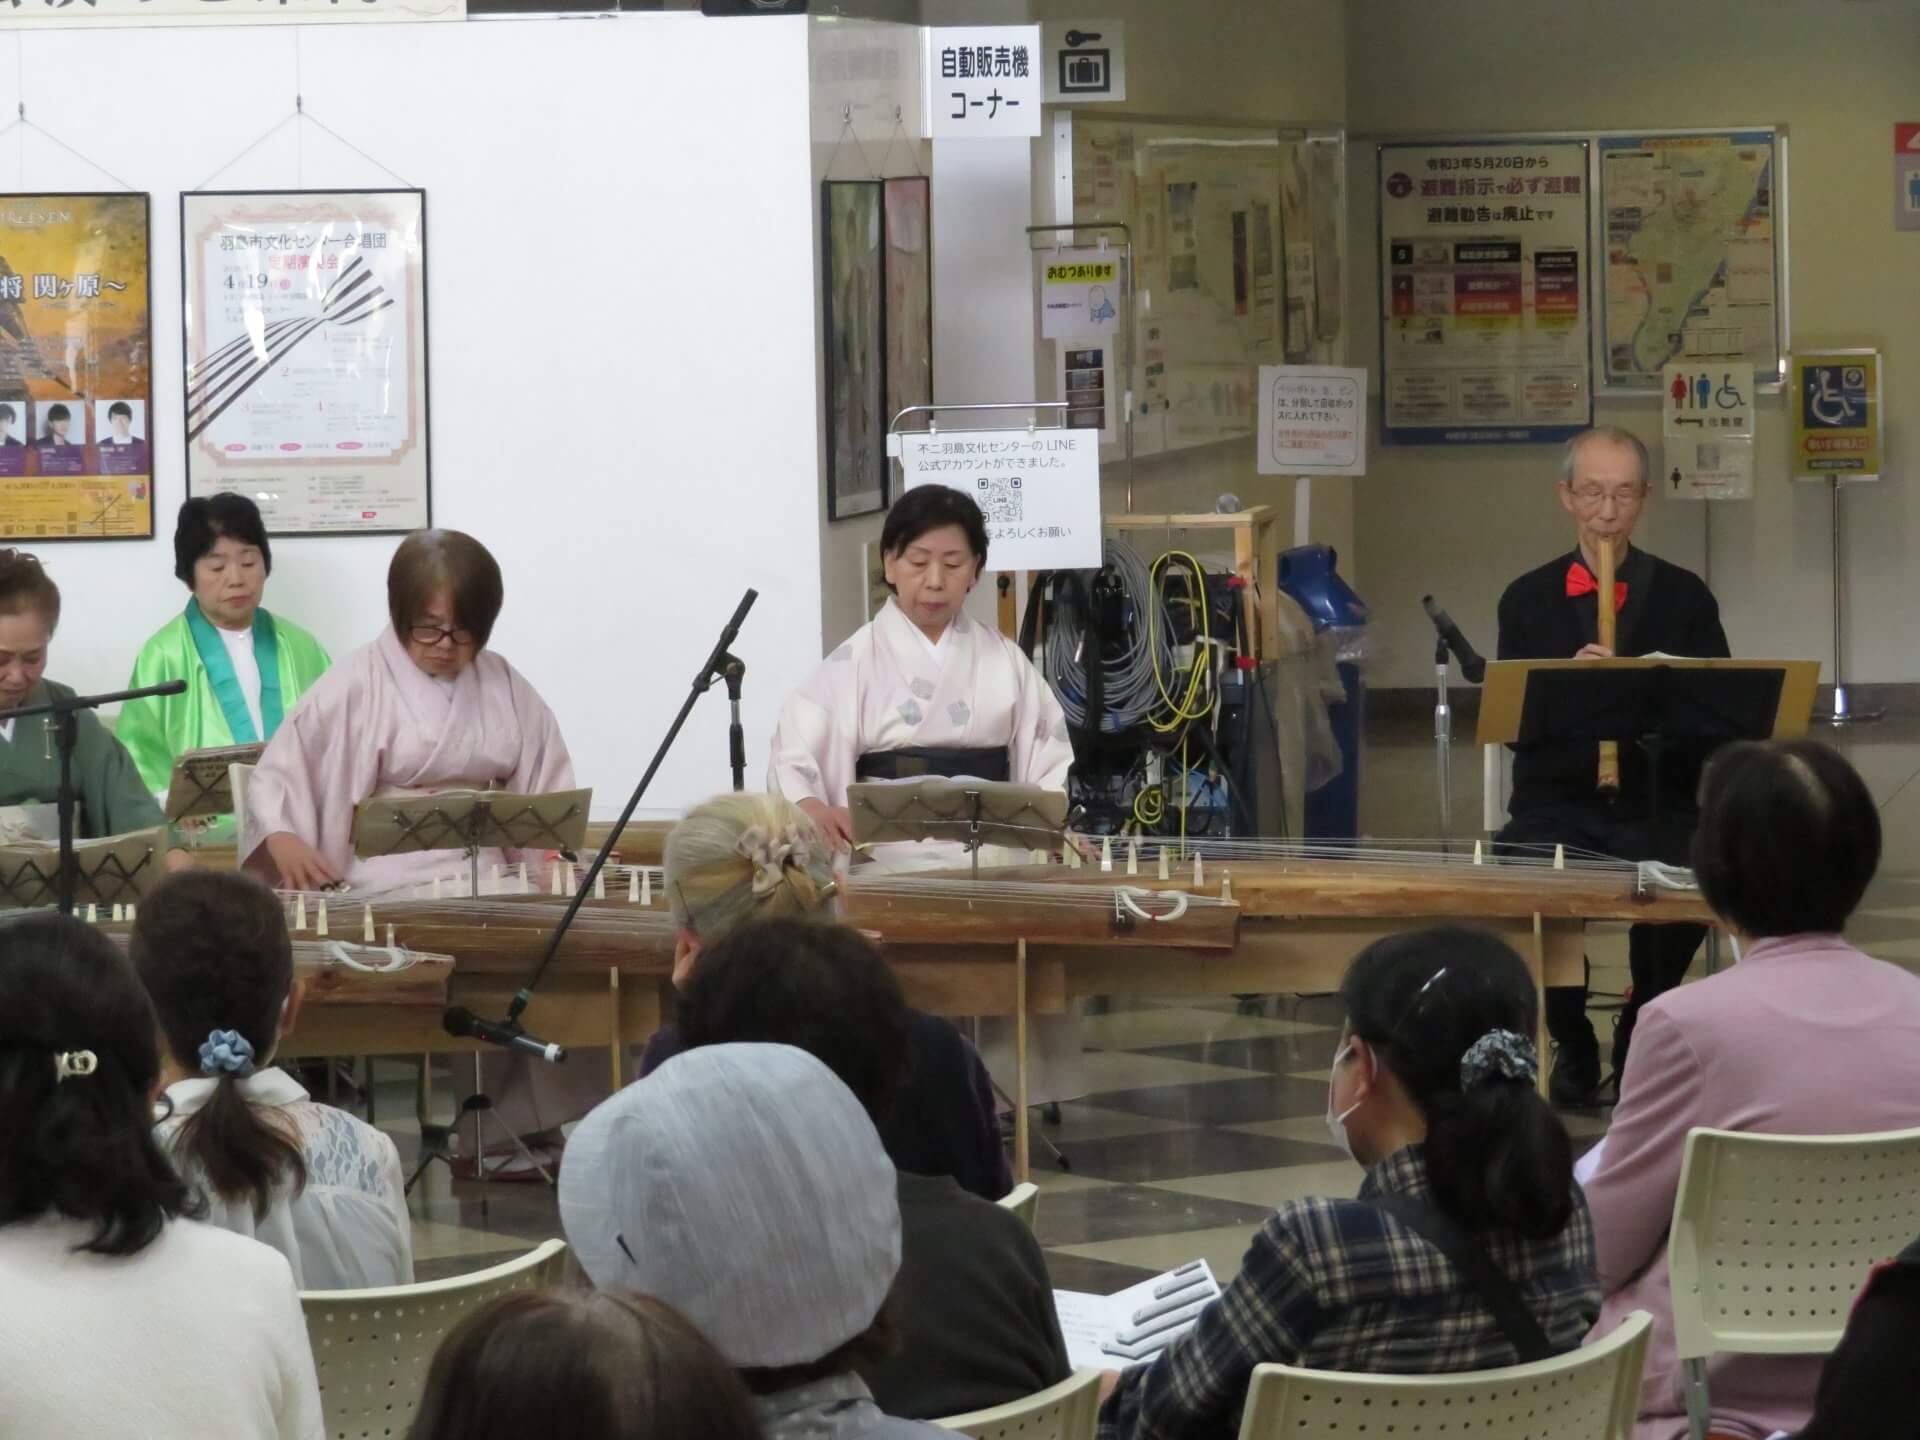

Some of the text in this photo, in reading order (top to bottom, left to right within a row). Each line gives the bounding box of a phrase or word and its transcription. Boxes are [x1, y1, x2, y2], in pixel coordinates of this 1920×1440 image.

[941, 46, 1029, 78] 自動販売機
[951, 88, 1019, 119] コーナー
[1047, 264, 1111, 278] おむつあります
[918, 439, 1076, 455] 不二羽島文化センターの LINE
[918, 457, 1066, 472] 公式アカウントができました。
